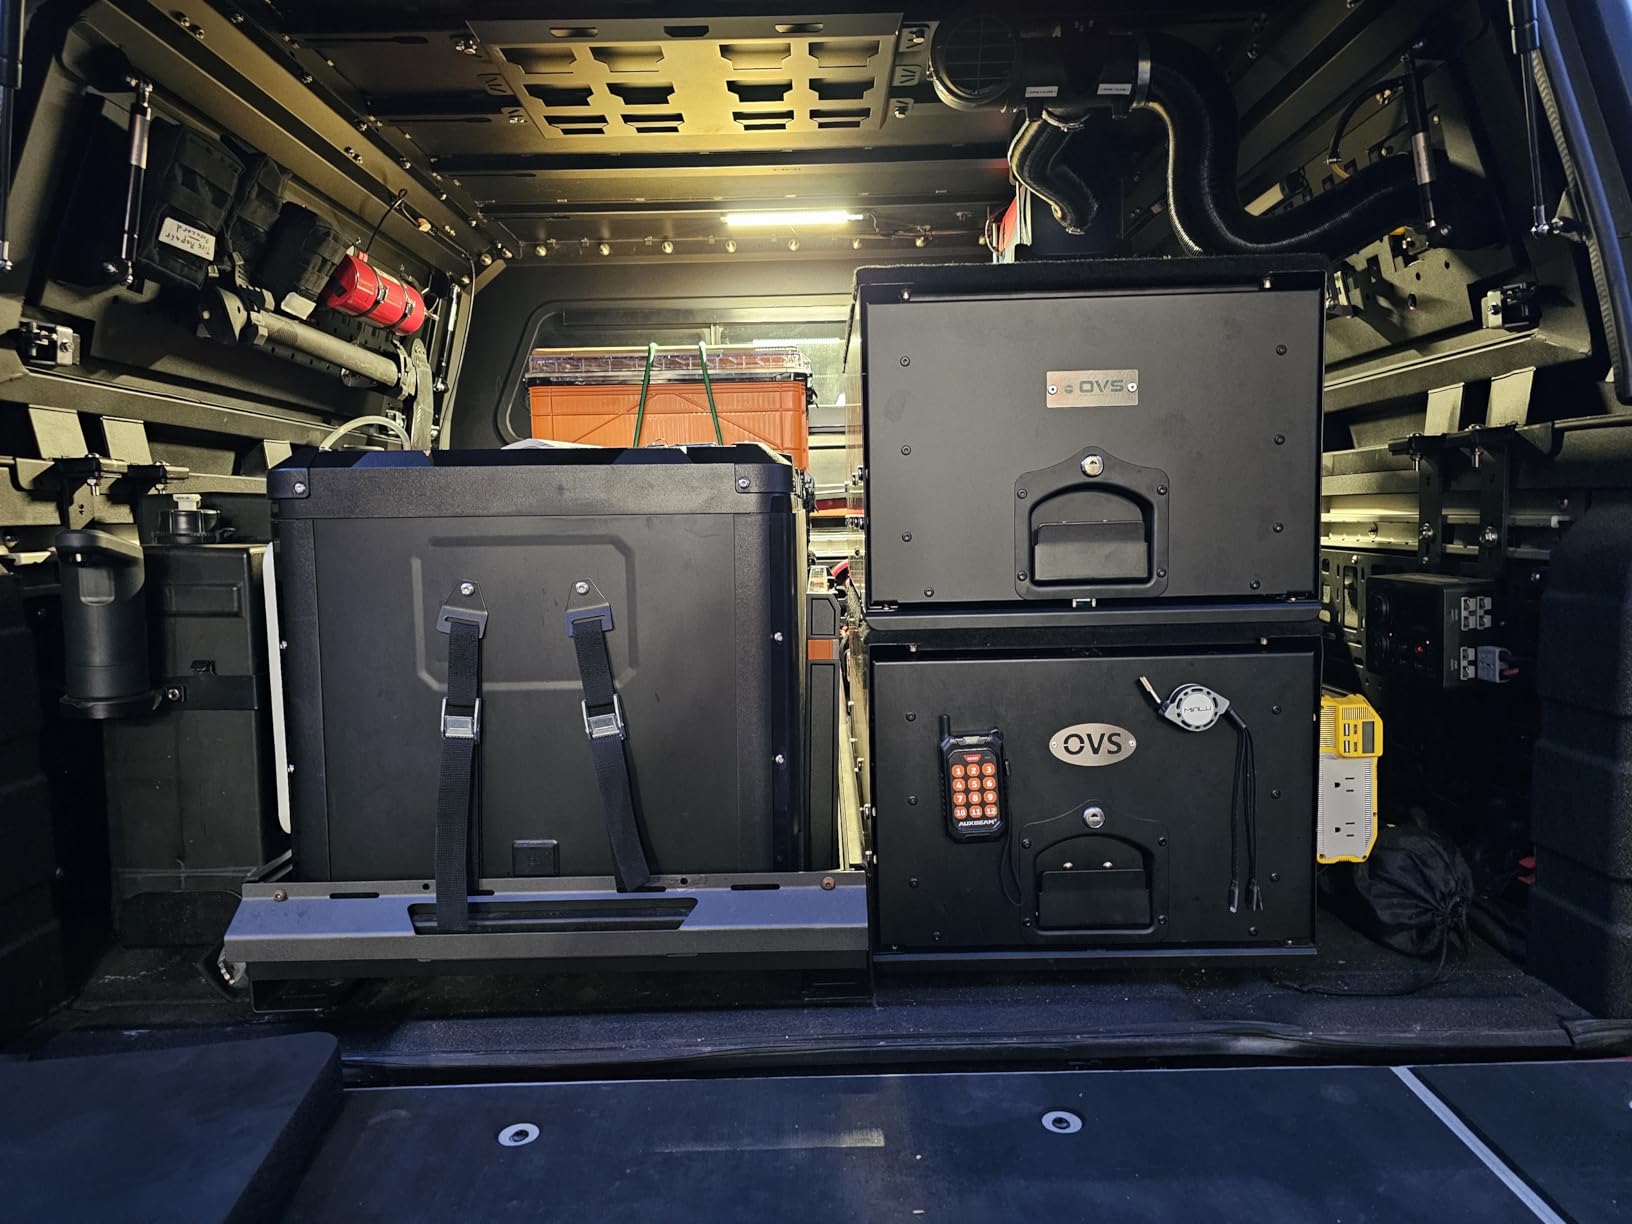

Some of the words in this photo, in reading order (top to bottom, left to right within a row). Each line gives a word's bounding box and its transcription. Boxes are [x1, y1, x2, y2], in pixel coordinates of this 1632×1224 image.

[165, 232, 195, 249] Repair
[1079, 380, 1124, 393] OVS
[1064, 733, 1122, 755] OVS
